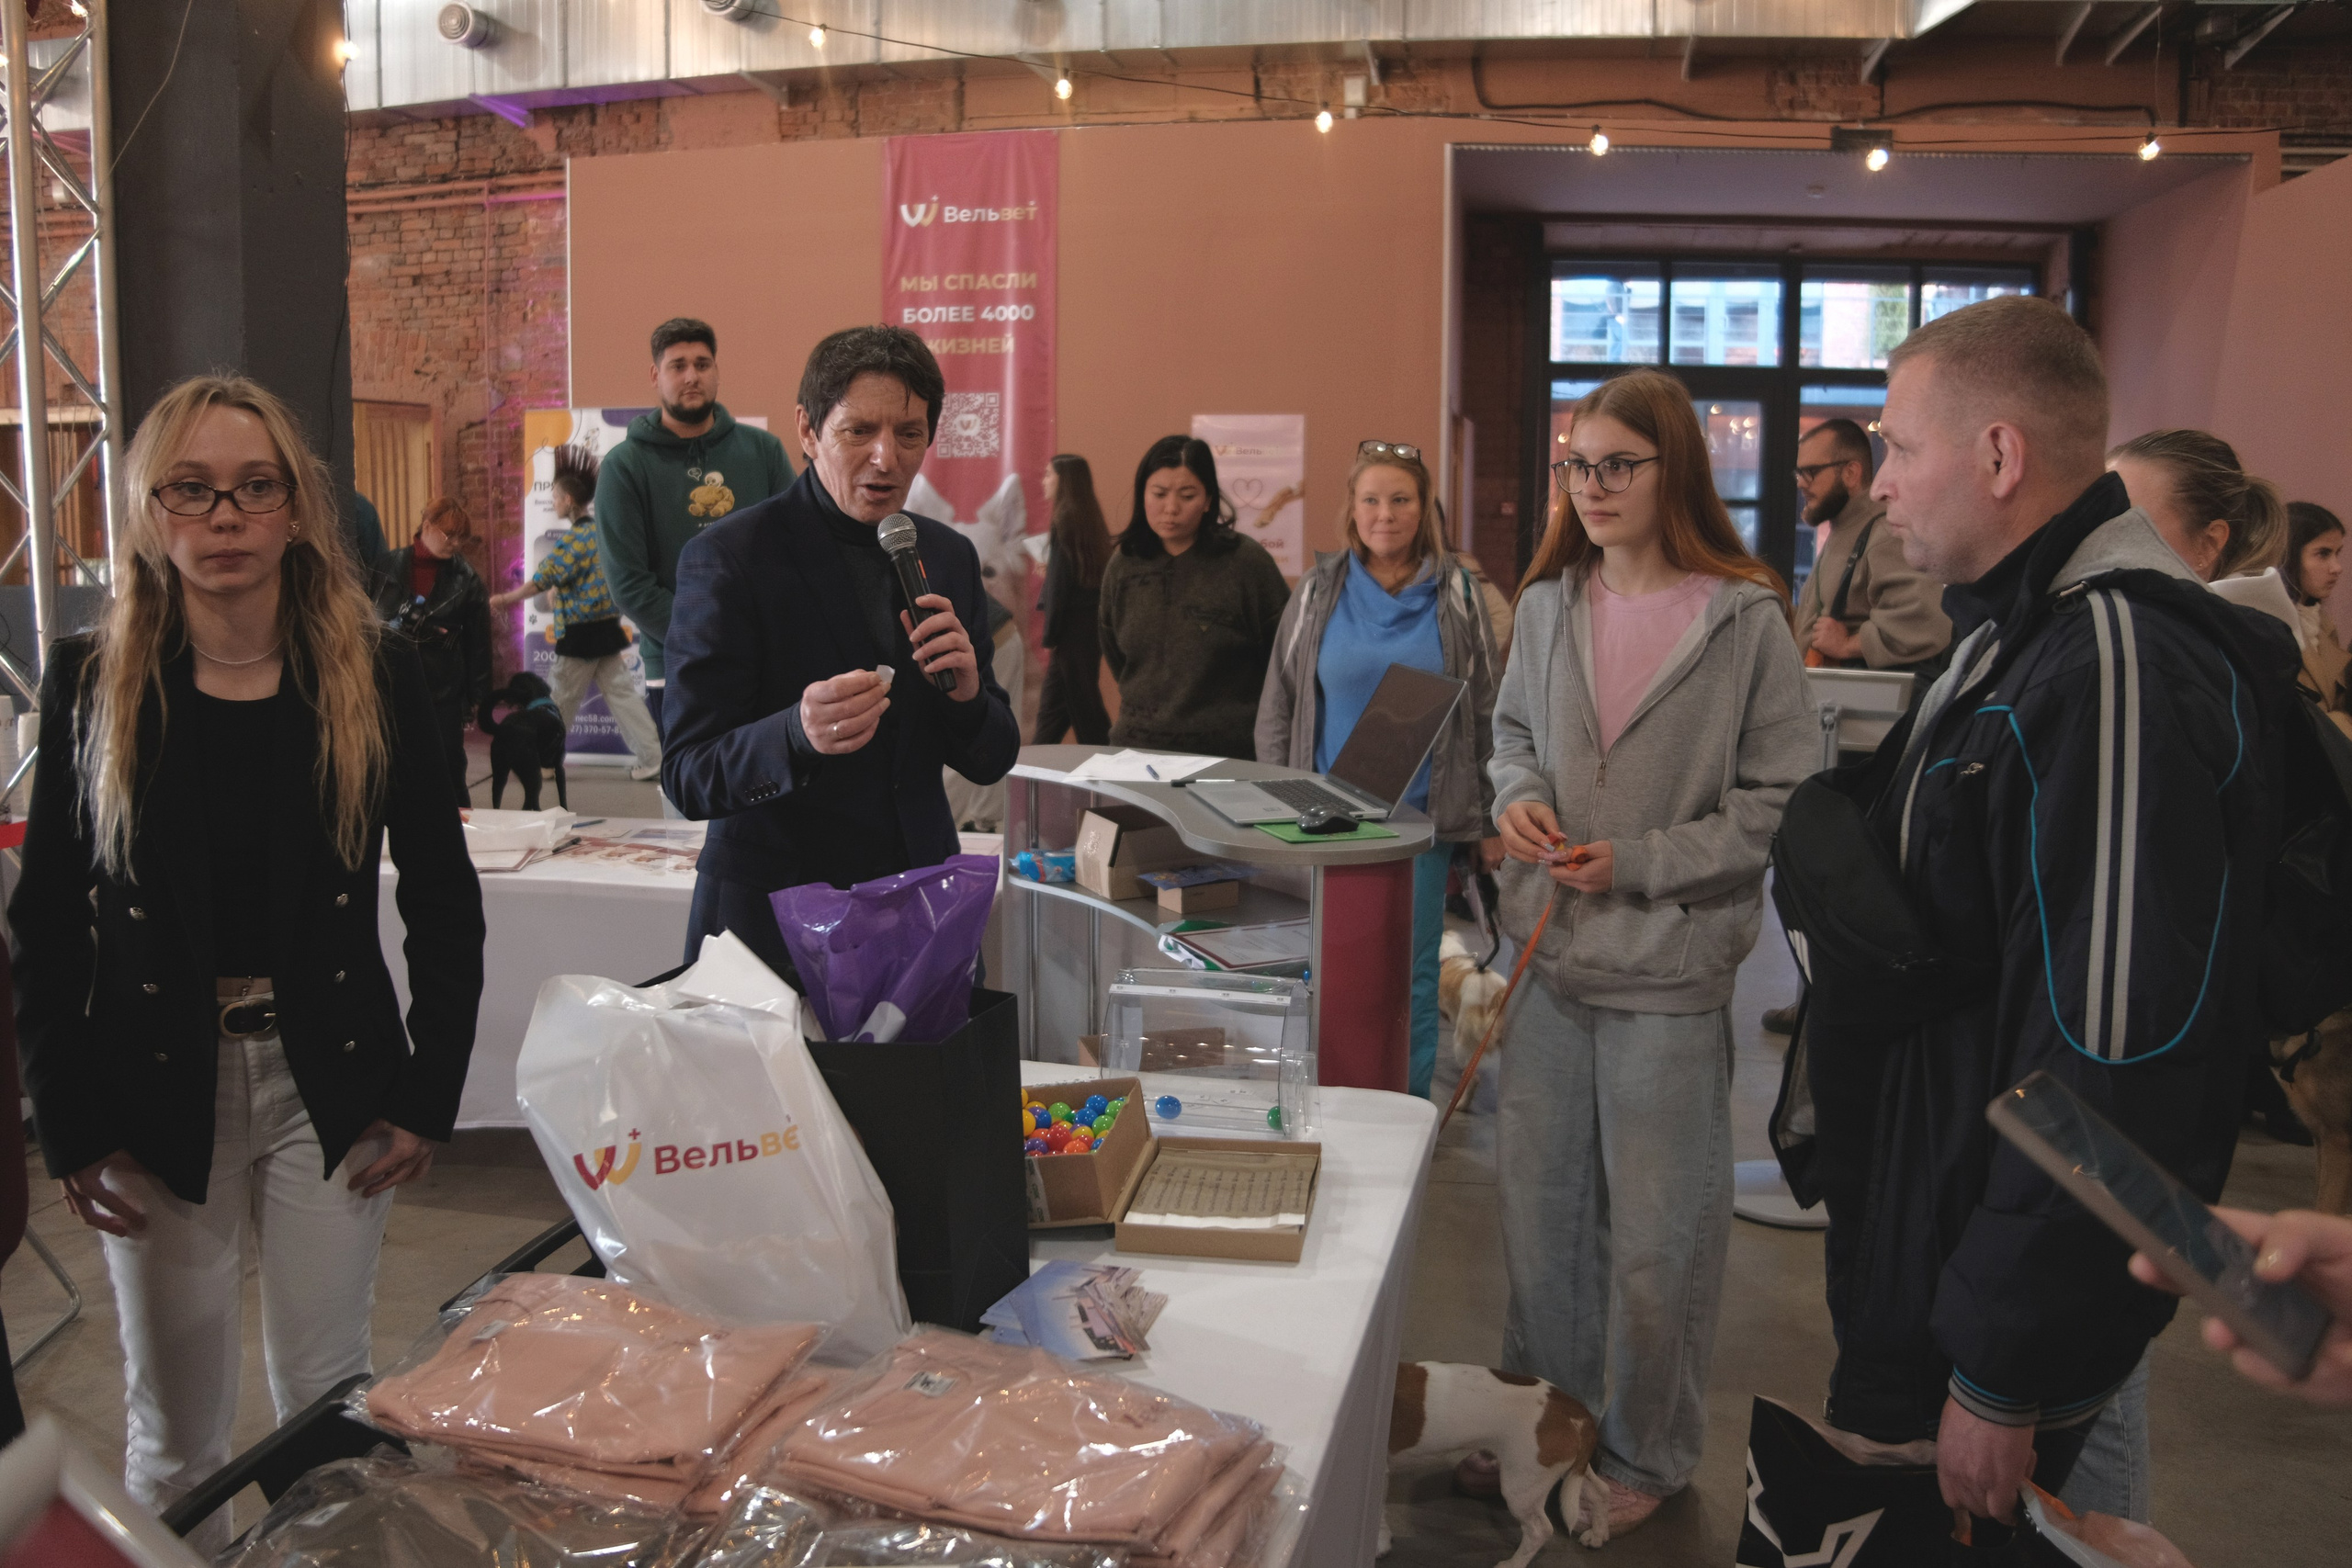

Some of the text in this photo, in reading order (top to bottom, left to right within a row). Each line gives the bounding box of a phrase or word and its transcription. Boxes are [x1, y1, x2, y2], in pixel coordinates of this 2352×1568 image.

[944, 204, 1038, 223] Вельвет
[900, 273, 1037, 292] МЫ СПАСЛИ
[903, 304, 1035, 323] БОЛЕЕ 4000
[1260, 538, 1283, 548] бой
[584, 725, 621, 734] 370-57-8
[654, 1124, 800, 1175] Вельве
